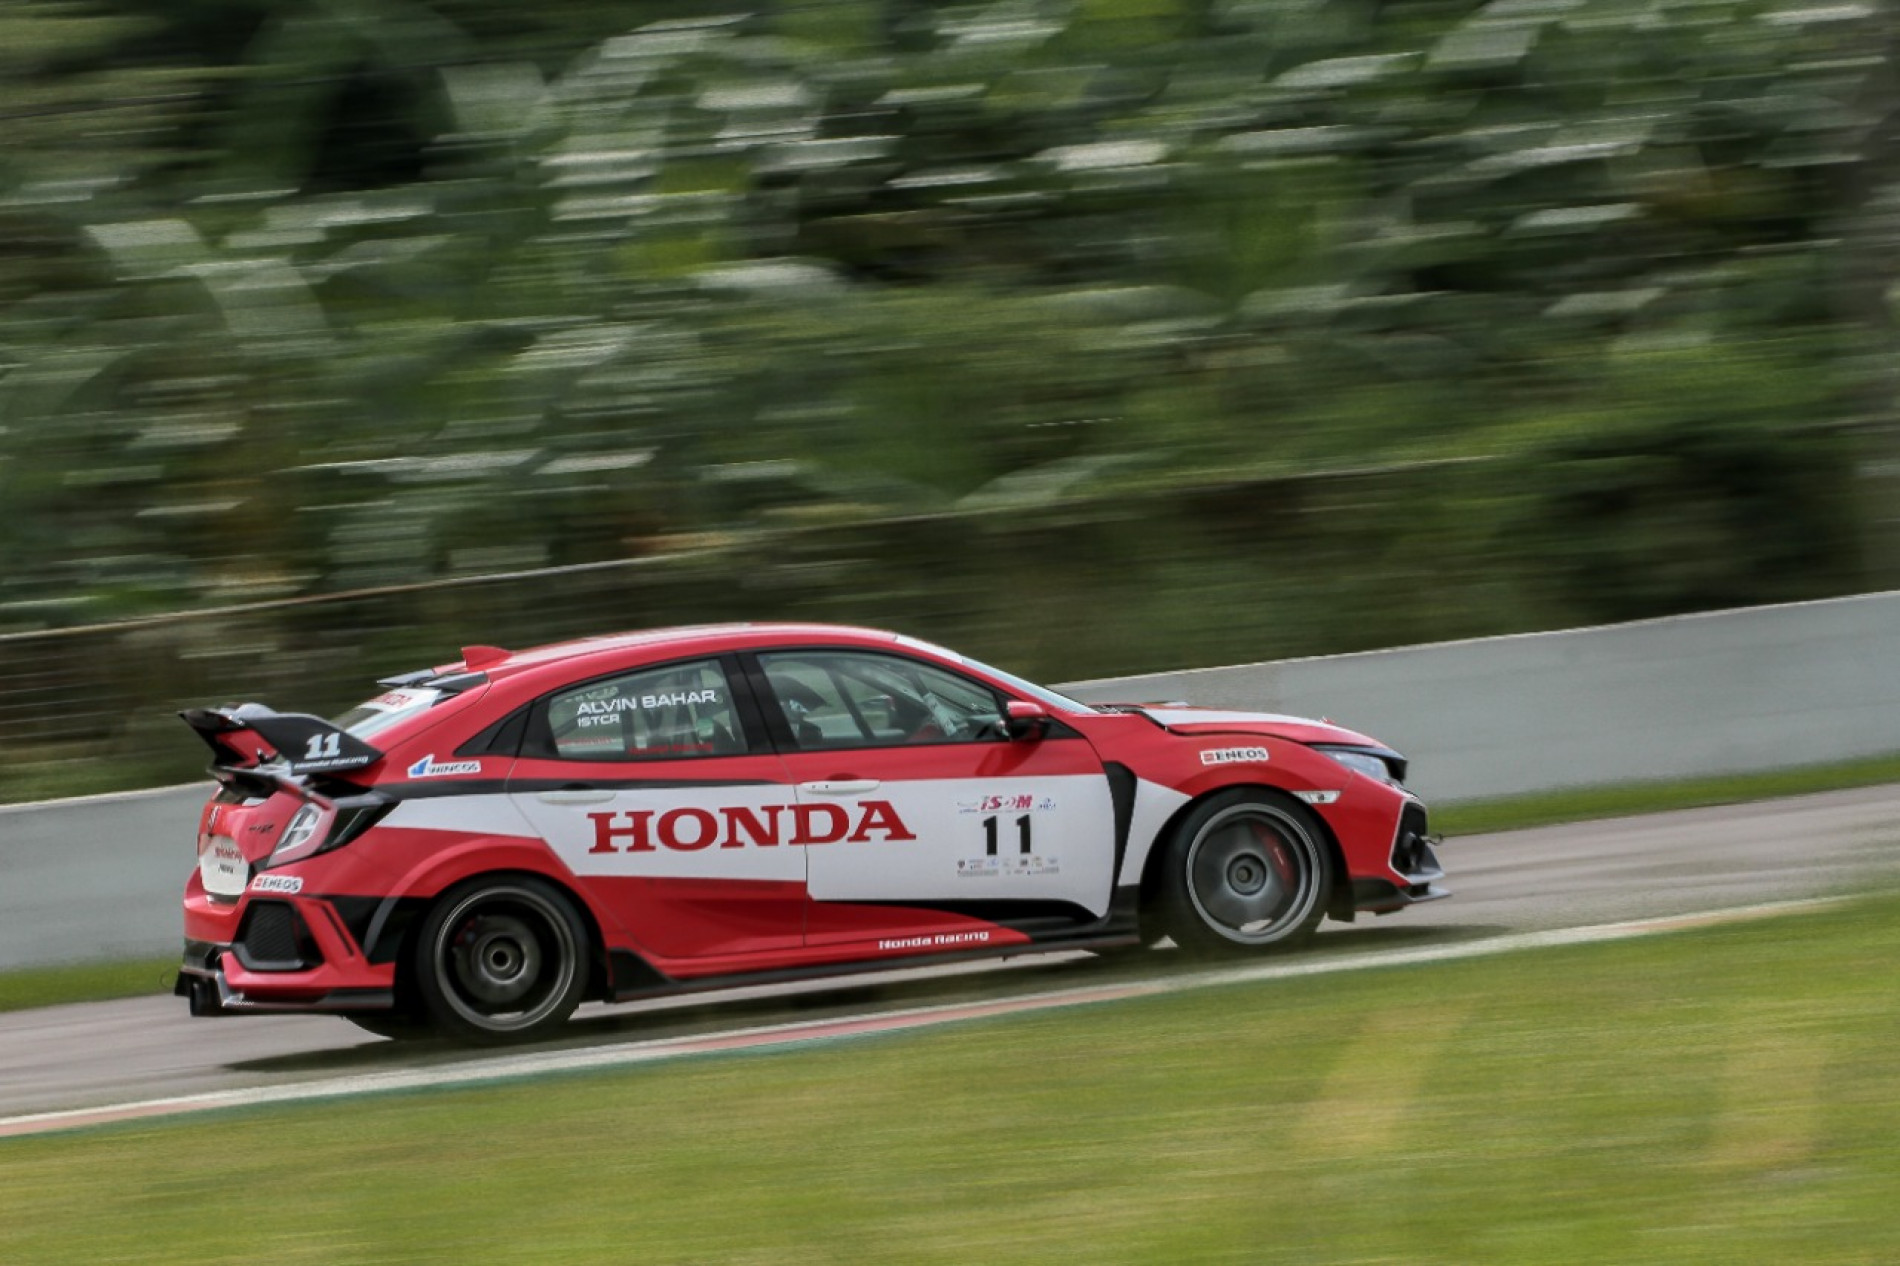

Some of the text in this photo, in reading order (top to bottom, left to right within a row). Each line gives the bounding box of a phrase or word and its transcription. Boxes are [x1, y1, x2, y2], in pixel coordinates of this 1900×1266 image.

[577, 690, 716, 716] ALVIN BAHAR
[304, 732, 341, 760] 11
[1216, 750, 1266, 760] ENEOS
[587, 800, 917, 854] HONDA
[262, 879, 299, 891] ENEOS
[879, 932, 989, 950] Honda Racing
